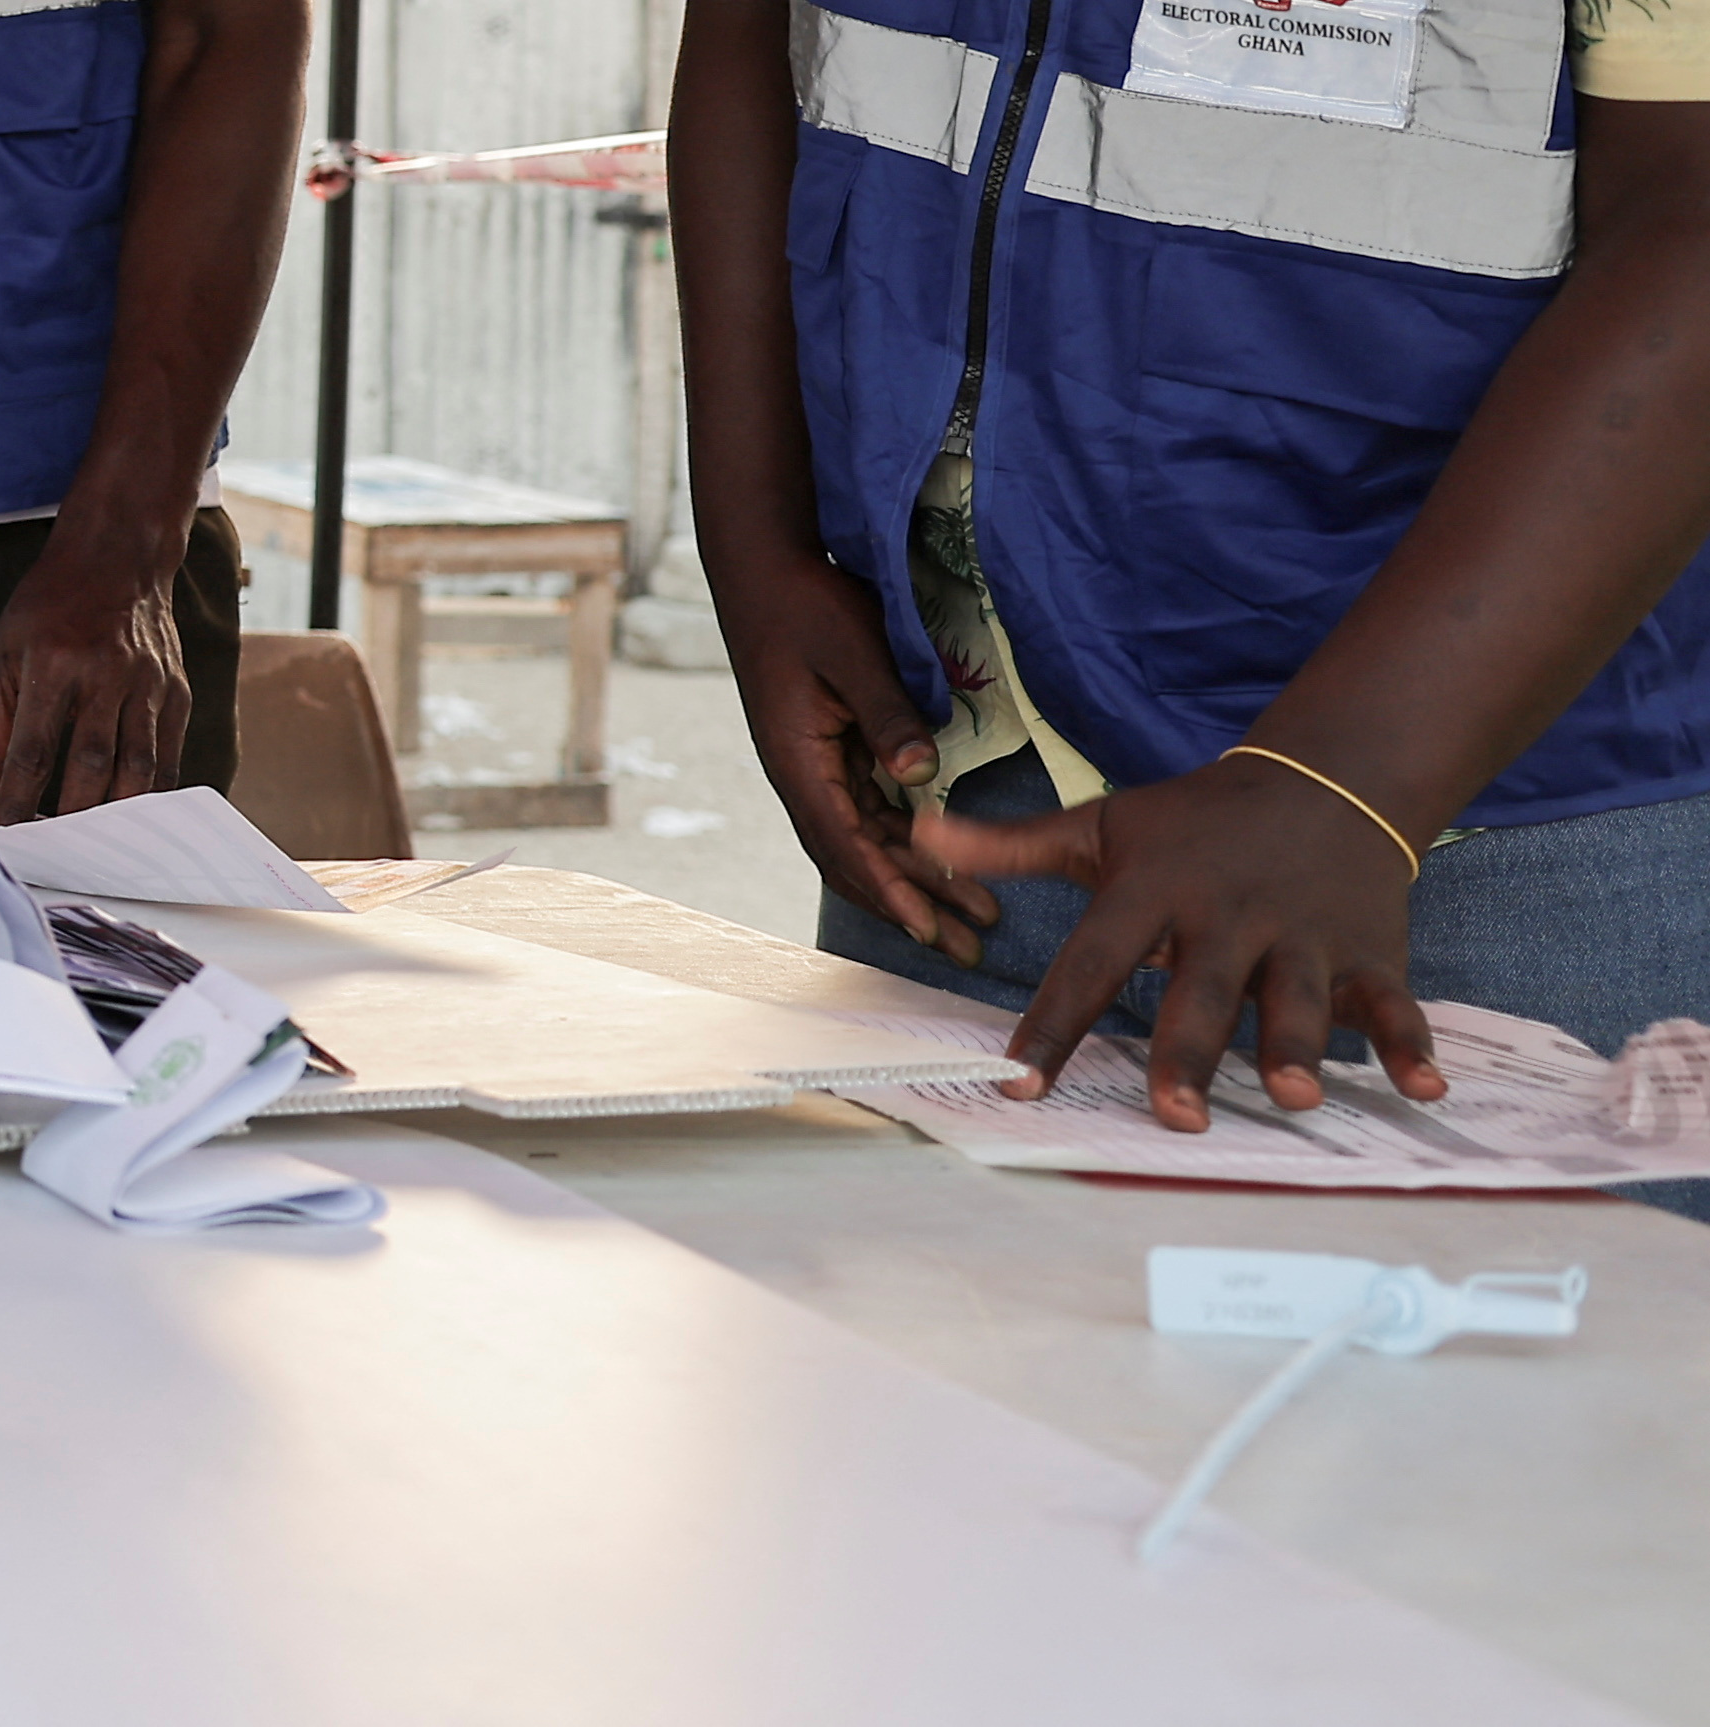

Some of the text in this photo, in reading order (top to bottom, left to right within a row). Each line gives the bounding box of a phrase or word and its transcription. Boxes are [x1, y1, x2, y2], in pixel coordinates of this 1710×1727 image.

[1162, 2, 1393, 47] ELECTORAL COMMISSION
[1238, 33, 1305, 57] GHANA
